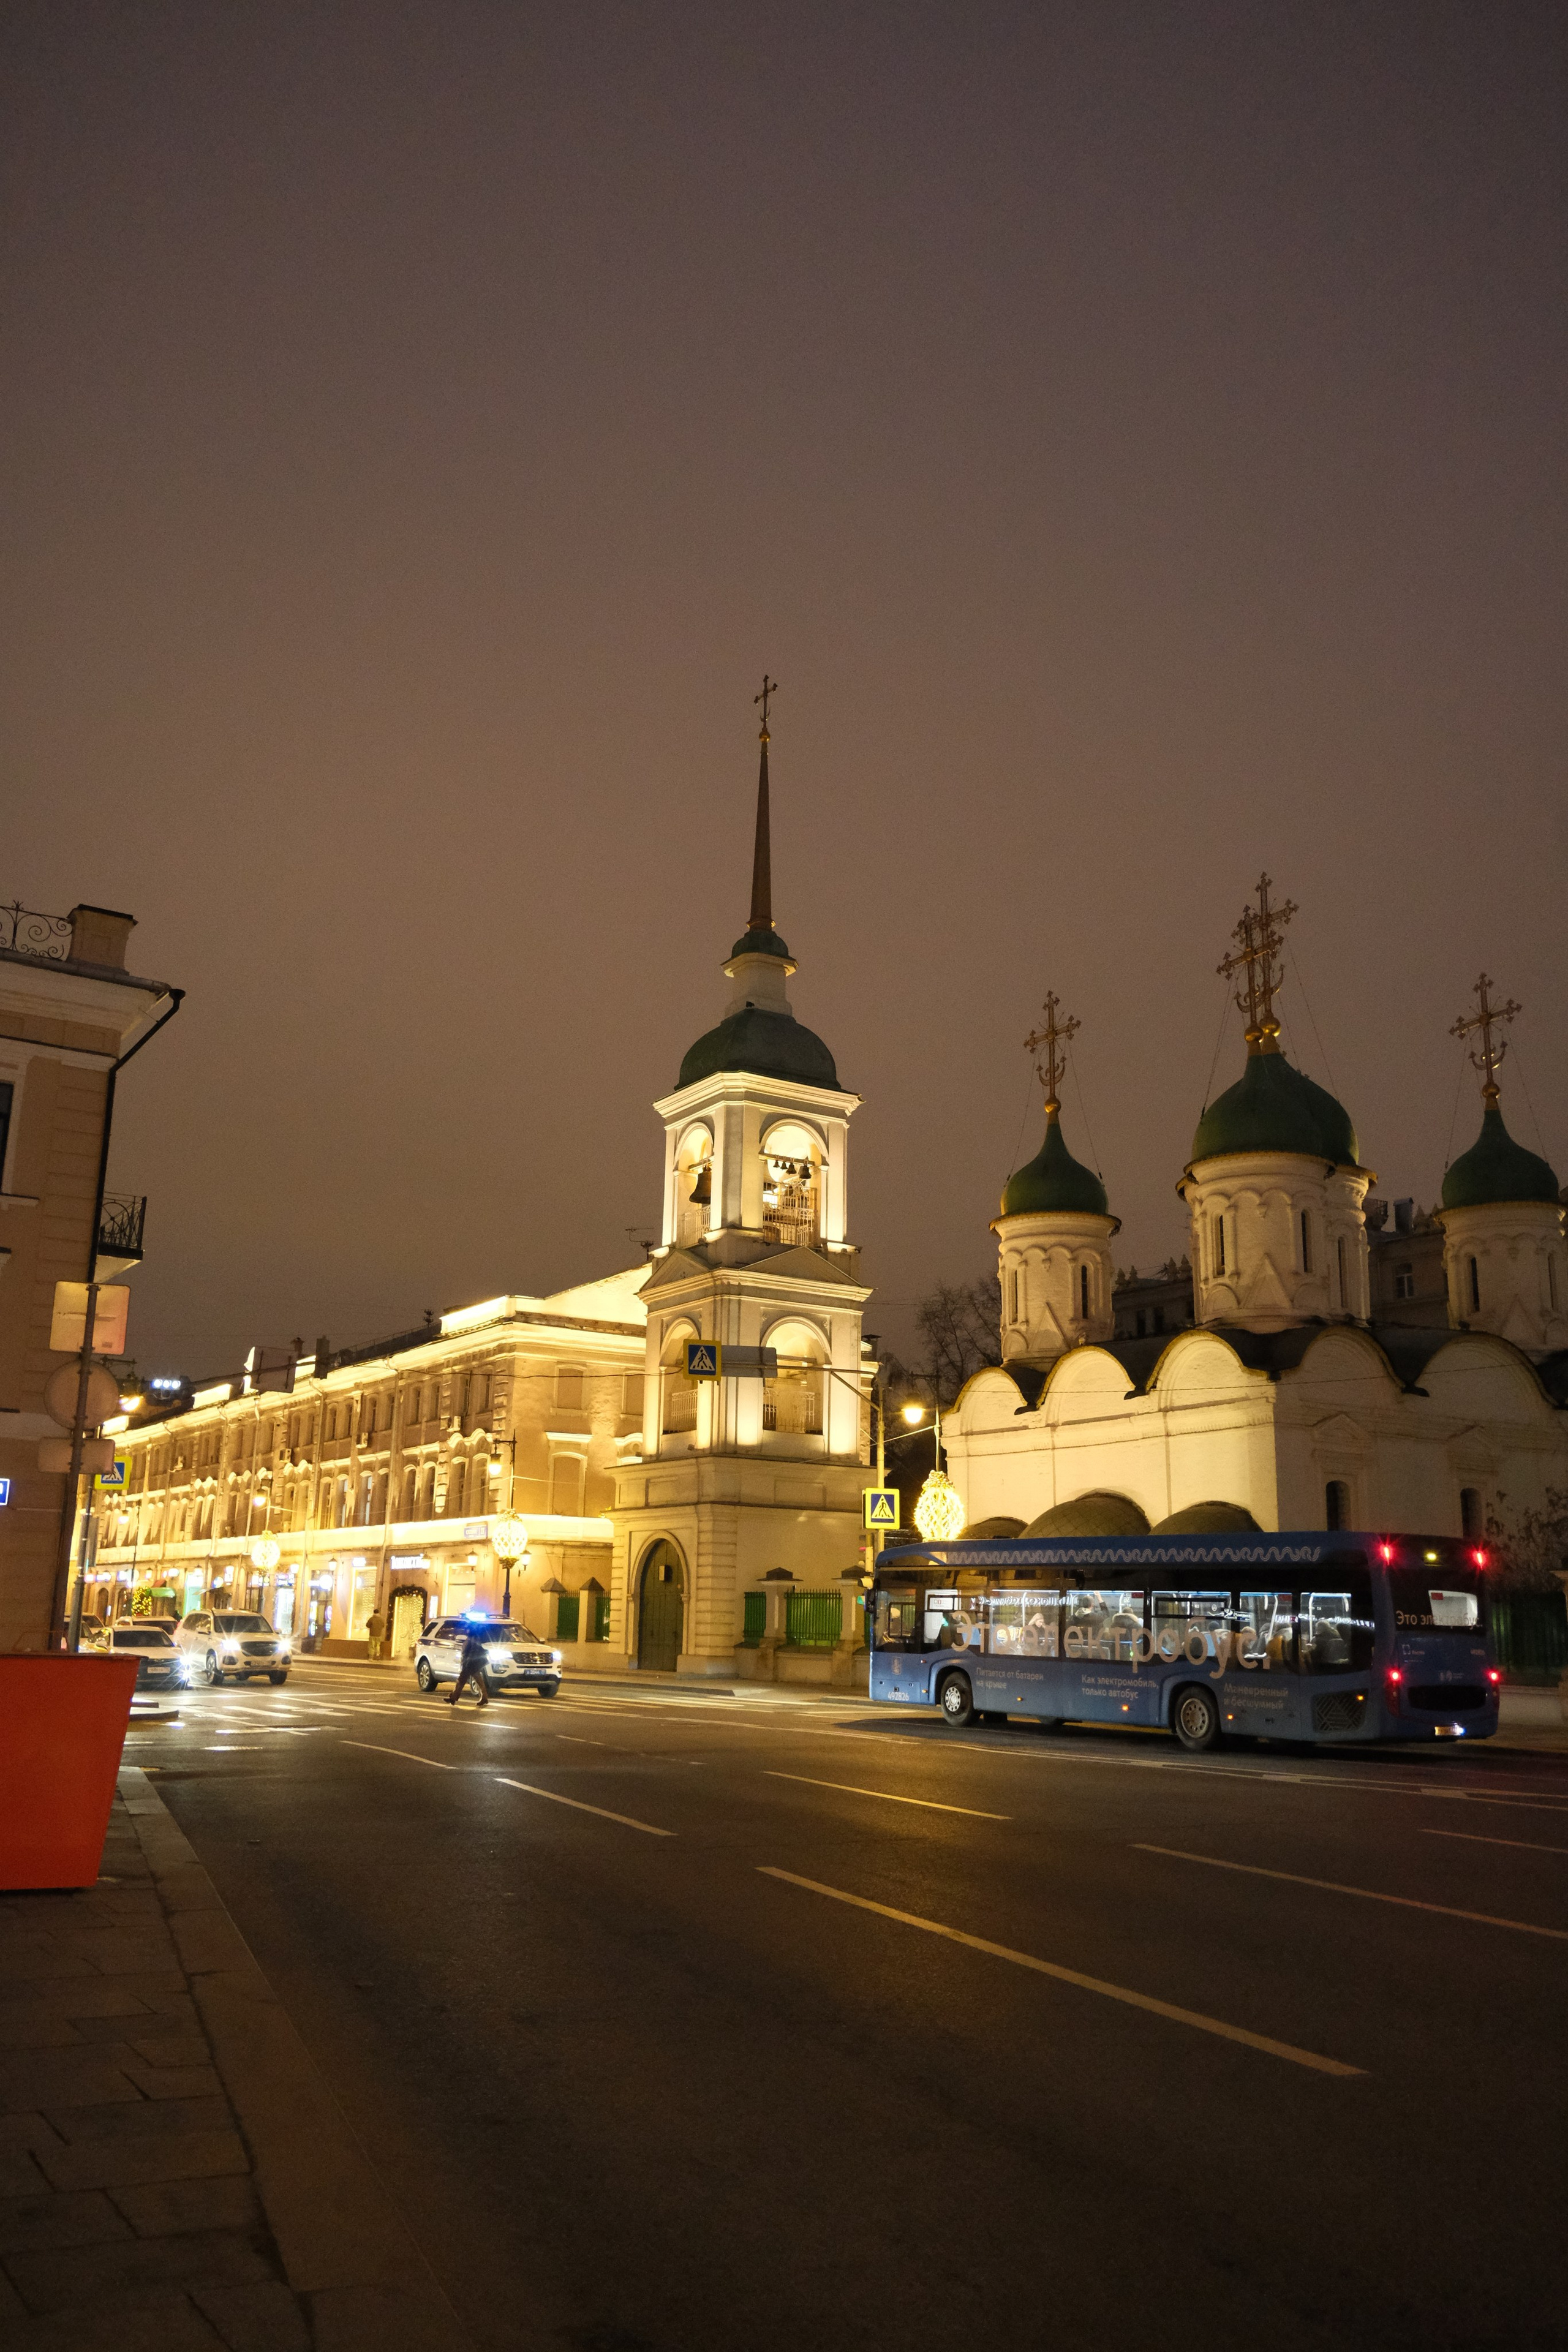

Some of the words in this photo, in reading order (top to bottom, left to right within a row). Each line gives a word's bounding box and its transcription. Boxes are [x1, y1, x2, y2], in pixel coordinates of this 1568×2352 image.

[1396, 1610, 1418, 1626] Это
[951, 1610, 1011, 1656] Это
[976, 1667, 1005, 1678] Питается
[985, 1681, 1008, 1689] крыше
[1082, 1674, 1095, 1684] Как
[1097, 1676, 1159, 1689] электромобиль,
[888, 1691, 910, 1702] 492826
[1082, 1687, 1107, 1696] только
[1109, 1689, 1139, 1700] автобус
[1224, 1683, 1289, 1697] Маневренный
[1231, 1695, 1285, 1710] бесшумный
